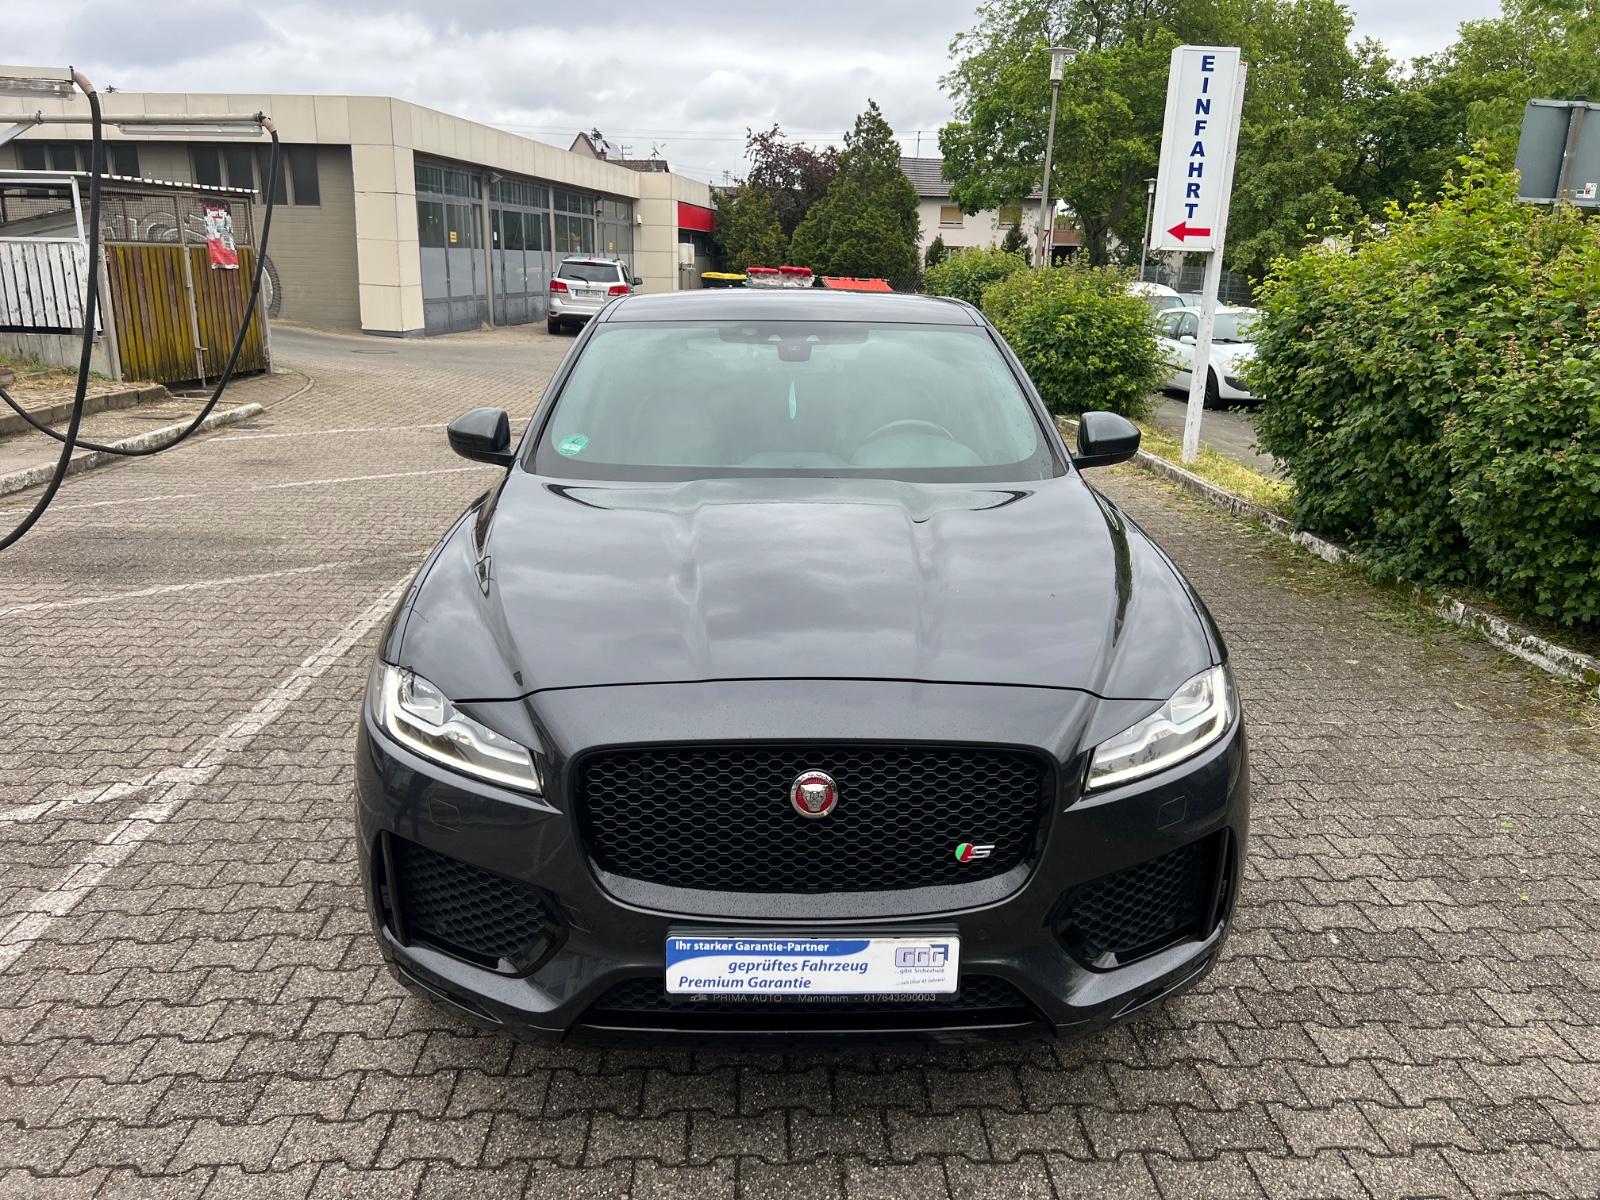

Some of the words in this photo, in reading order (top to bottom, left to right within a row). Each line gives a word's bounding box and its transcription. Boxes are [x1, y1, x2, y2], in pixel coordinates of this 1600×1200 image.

[1184, 55, 1216, 219] EINFAHRT
[675, 941, 691, 951] Ihr
[693, 941, 733, 951] starker
[735, 942, 829, 952] Garantie-Partner
[728, 960, 798, 974] geprüftes
[801, 960, 868, 974] Fahrzeug
[679, 976, 744, 988] Premium
[747, 977, 811, 988] Garantie
[713, 994, 747, 1002] PRIMA
[752, 994, 782, 1002] AUTO
[798, 993, 849, 1002] Mannheim
